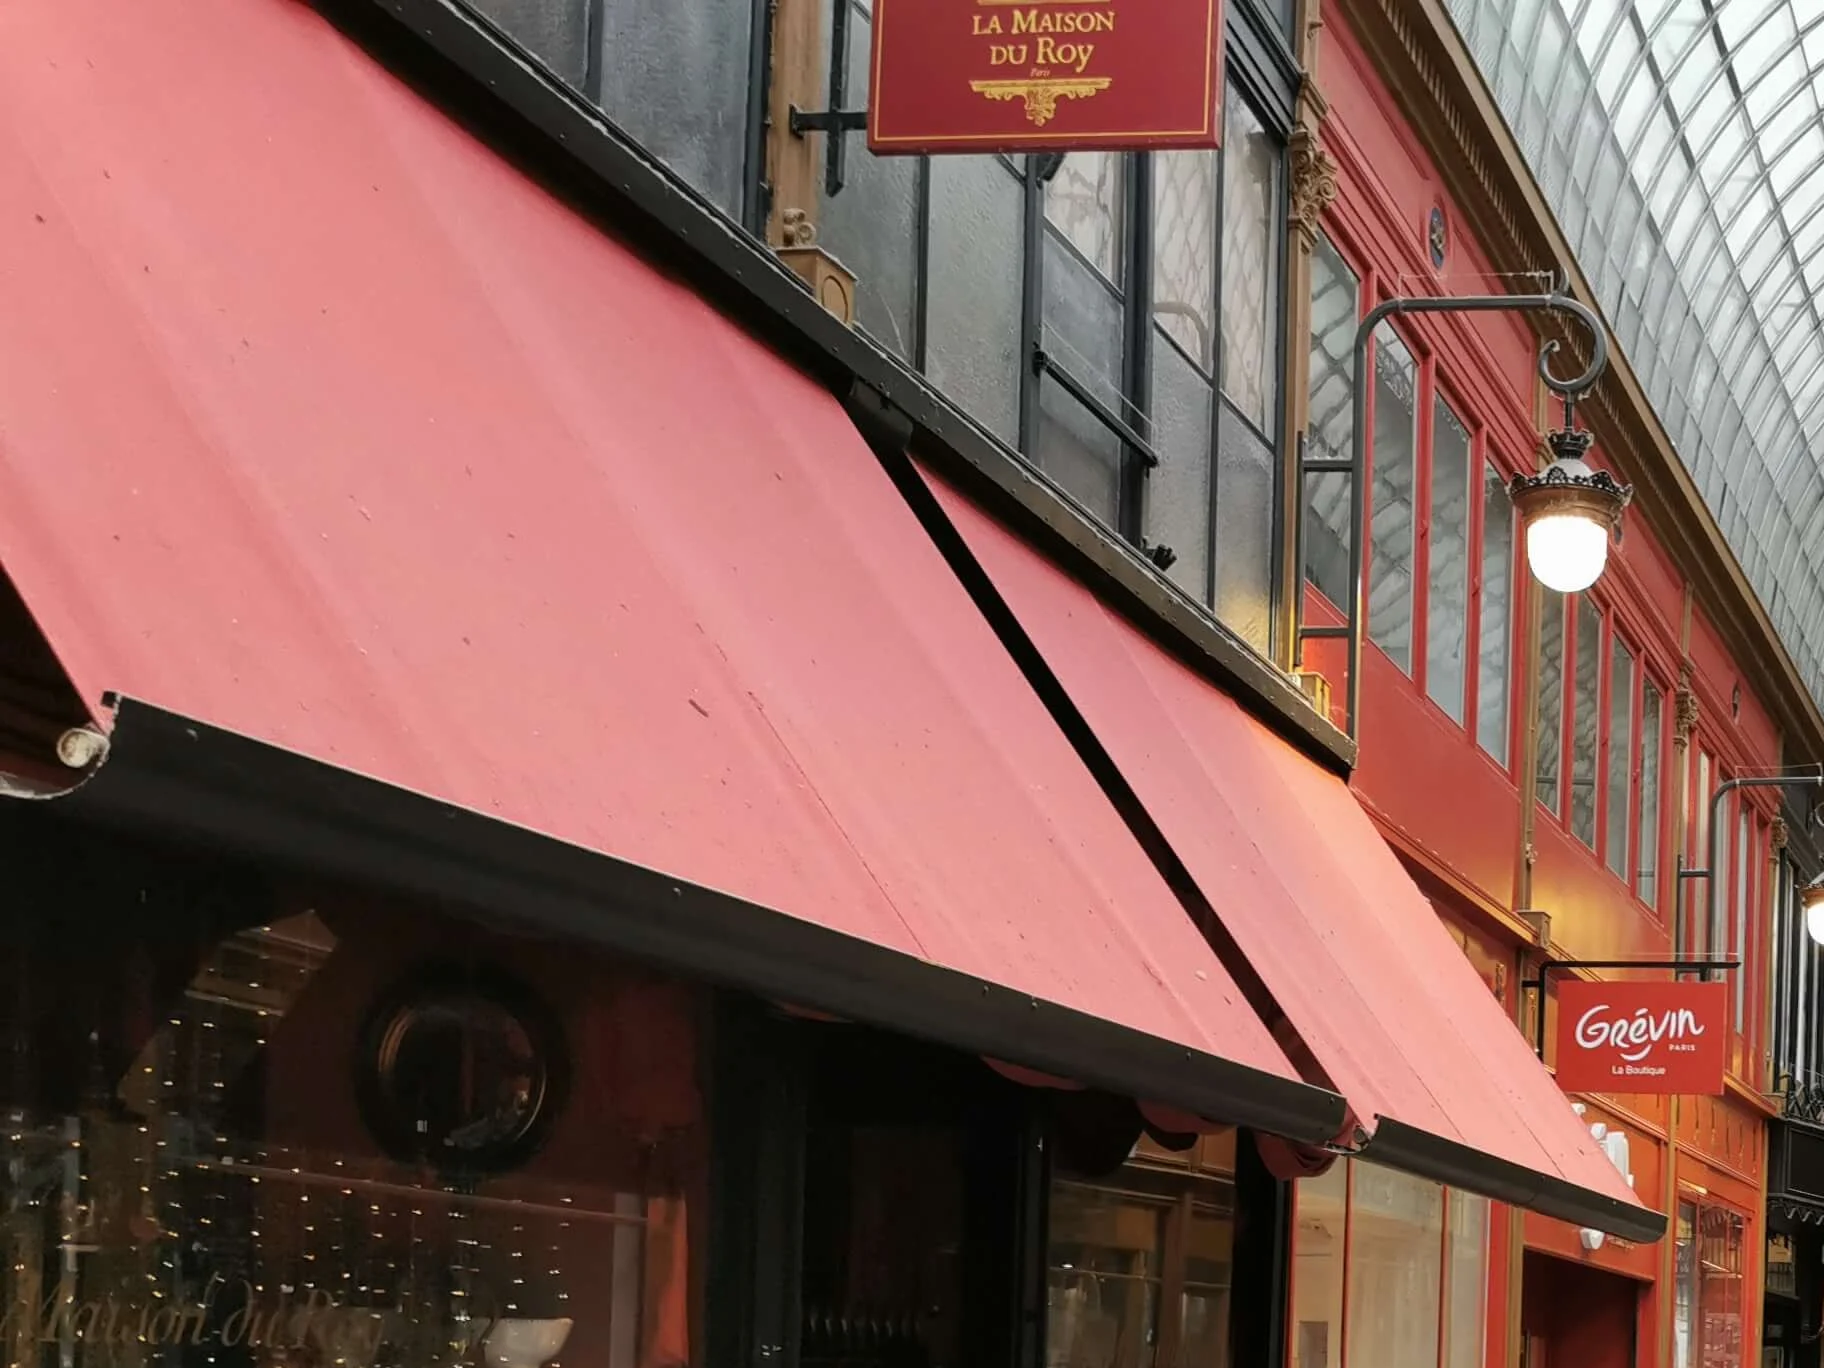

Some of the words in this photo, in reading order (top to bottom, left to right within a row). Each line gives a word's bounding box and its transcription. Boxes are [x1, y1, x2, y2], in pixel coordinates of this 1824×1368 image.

[972, 15, 1003, 35] LA
[990, 44, 1028, 66] DU
[1612, 1065, 1624, 1075] La
[1626, 1065, 1666, 1076] Boutique
